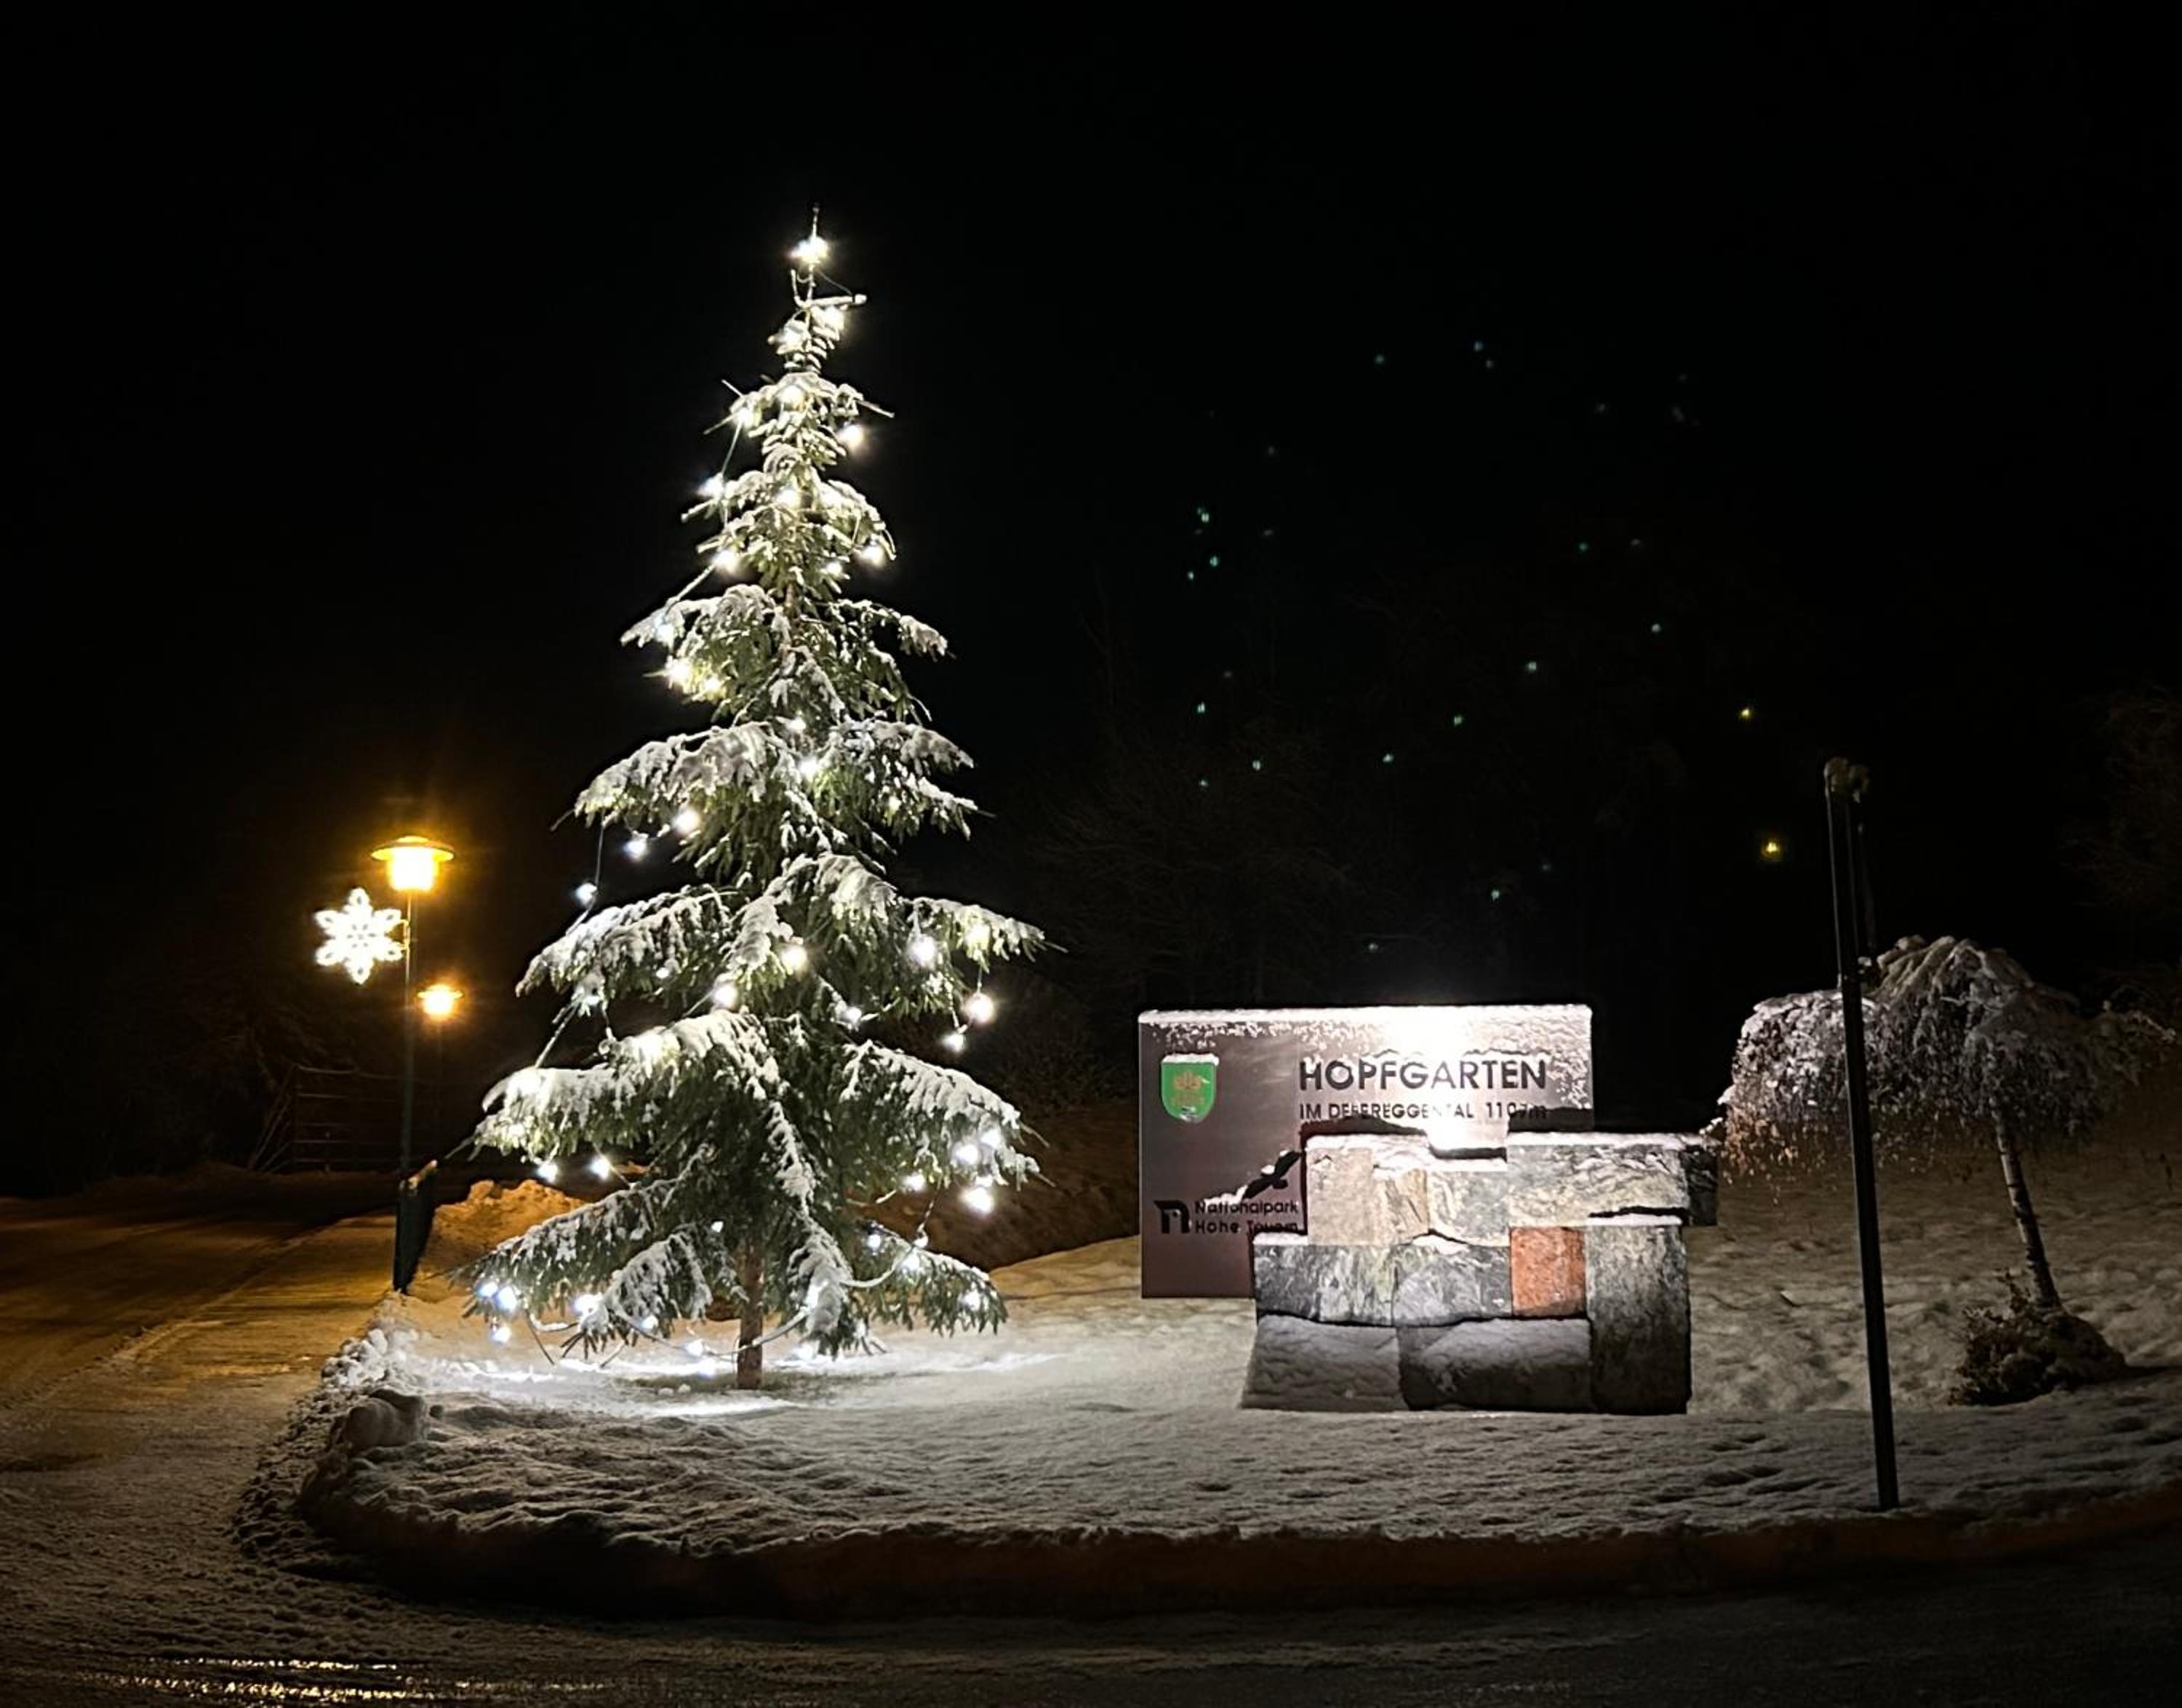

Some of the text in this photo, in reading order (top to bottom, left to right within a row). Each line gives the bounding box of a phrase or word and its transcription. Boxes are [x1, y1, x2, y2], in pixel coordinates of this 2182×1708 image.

[1300, 1059, 1547, 1090] HOPFGARTEN
[1300, 1102, 1322, 1120] IM
[1195, 1220, 1239, 1234] Hohe
